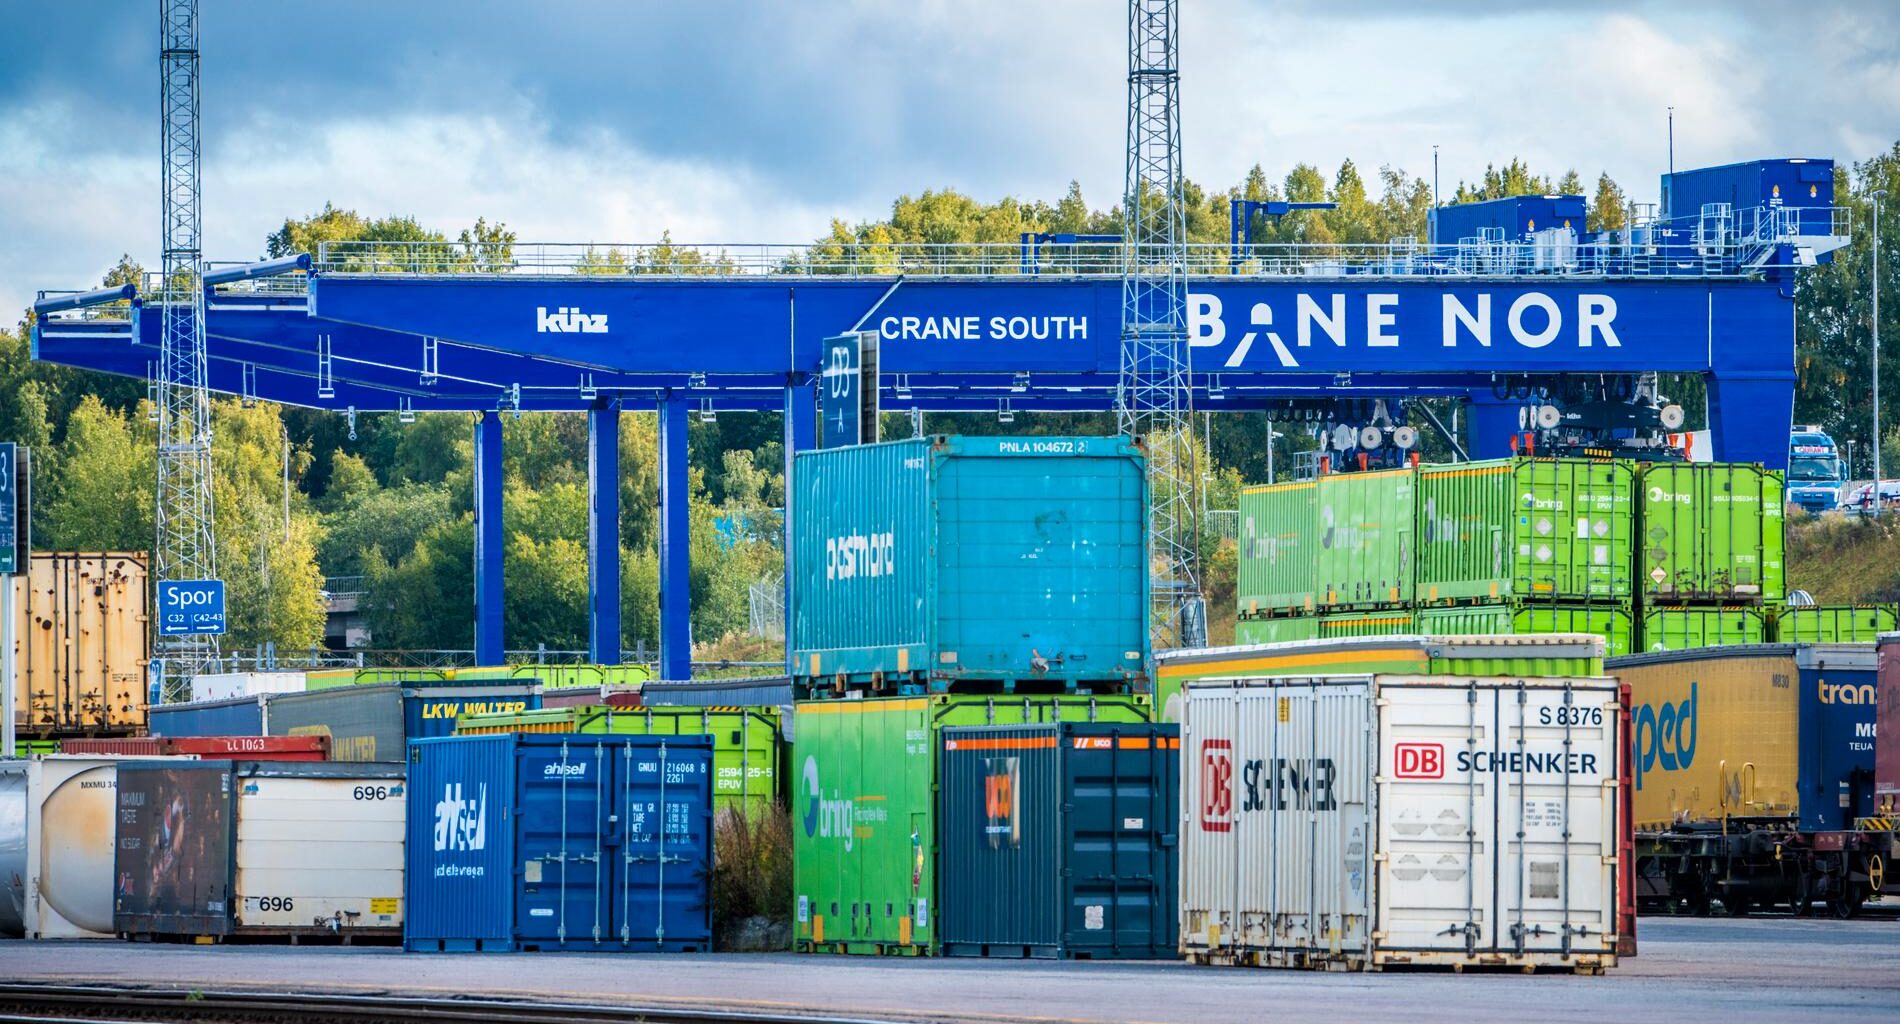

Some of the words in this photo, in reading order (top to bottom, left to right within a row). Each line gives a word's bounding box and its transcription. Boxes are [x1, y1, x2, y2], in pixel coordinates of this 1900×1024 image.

[537, 307, 608, 333] künz
[1443, 292, 1621, 348] NOR
[881, 316, 980, 340] CRANE
[989, 316, 1087, 340] SOUTH
[832, 347, 849, 398] D3
[1000, 442, 1030, 452] PNLA
[1033, 442, 1073, 452] 104672
[1664, 492, 1690, 504] bring
[1536, 499, 1563, 511] bring
[167, 587, 215, 609] Spor
[168, 614, 184, 622] C32
[193, 613, 223, 622] C42-43
[1818, 679, 1877, 704] tran
[422, 703, 459, 718] LKW
[1540, 707, 1551, 725] S
[1557, 707, 1602, 725] 8376
[241, 739, 265, 750] 1063
[1849, 742, 1873, 750] TEUA
[666, 763, 694, 773] 216068
[700, 763, 706, 773] 8
[1401, 749, 1438, 773] DB
[1456, 752, 1598, 774] SCHENKER
[543, 762, 587, 775] ahlsell
[718, 768, 742, 777] 2594
[747, 768, 773, 777] 25-5
[666, 773, 684, 783] 22G1
[718, 780, 742, 789] EPUV
[81, 781, 106, 789] MXMU
[1207, 755, 1231, 816] DB
[1243, 758, 1337, 811] SCHENKER
[353, 786, 387, 800] 696
[820, 788, 852, 852] bring
[260, 897, 293, 912] 696
